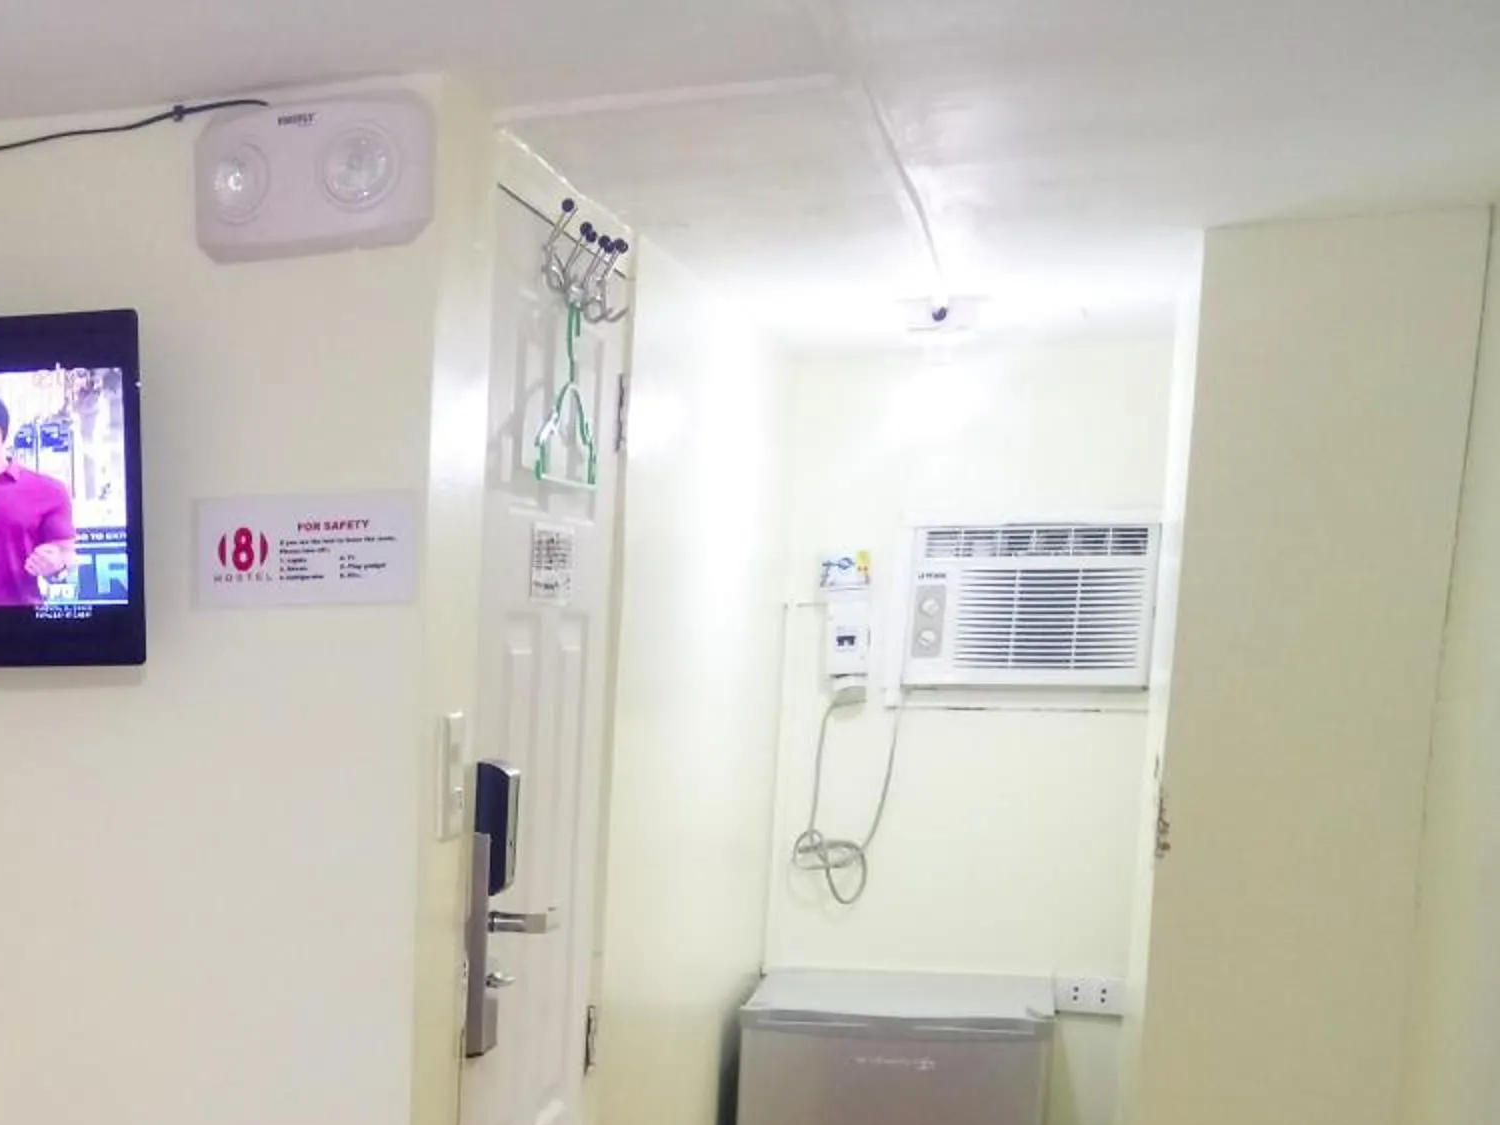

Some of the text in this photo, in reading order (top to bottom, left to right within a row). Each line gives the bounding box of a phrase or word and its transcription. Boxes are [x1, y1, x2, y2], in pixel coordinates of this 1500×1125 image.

[297, 519, 370, 532] FOR SAFETY
[232, 527, 255, 572] 8
